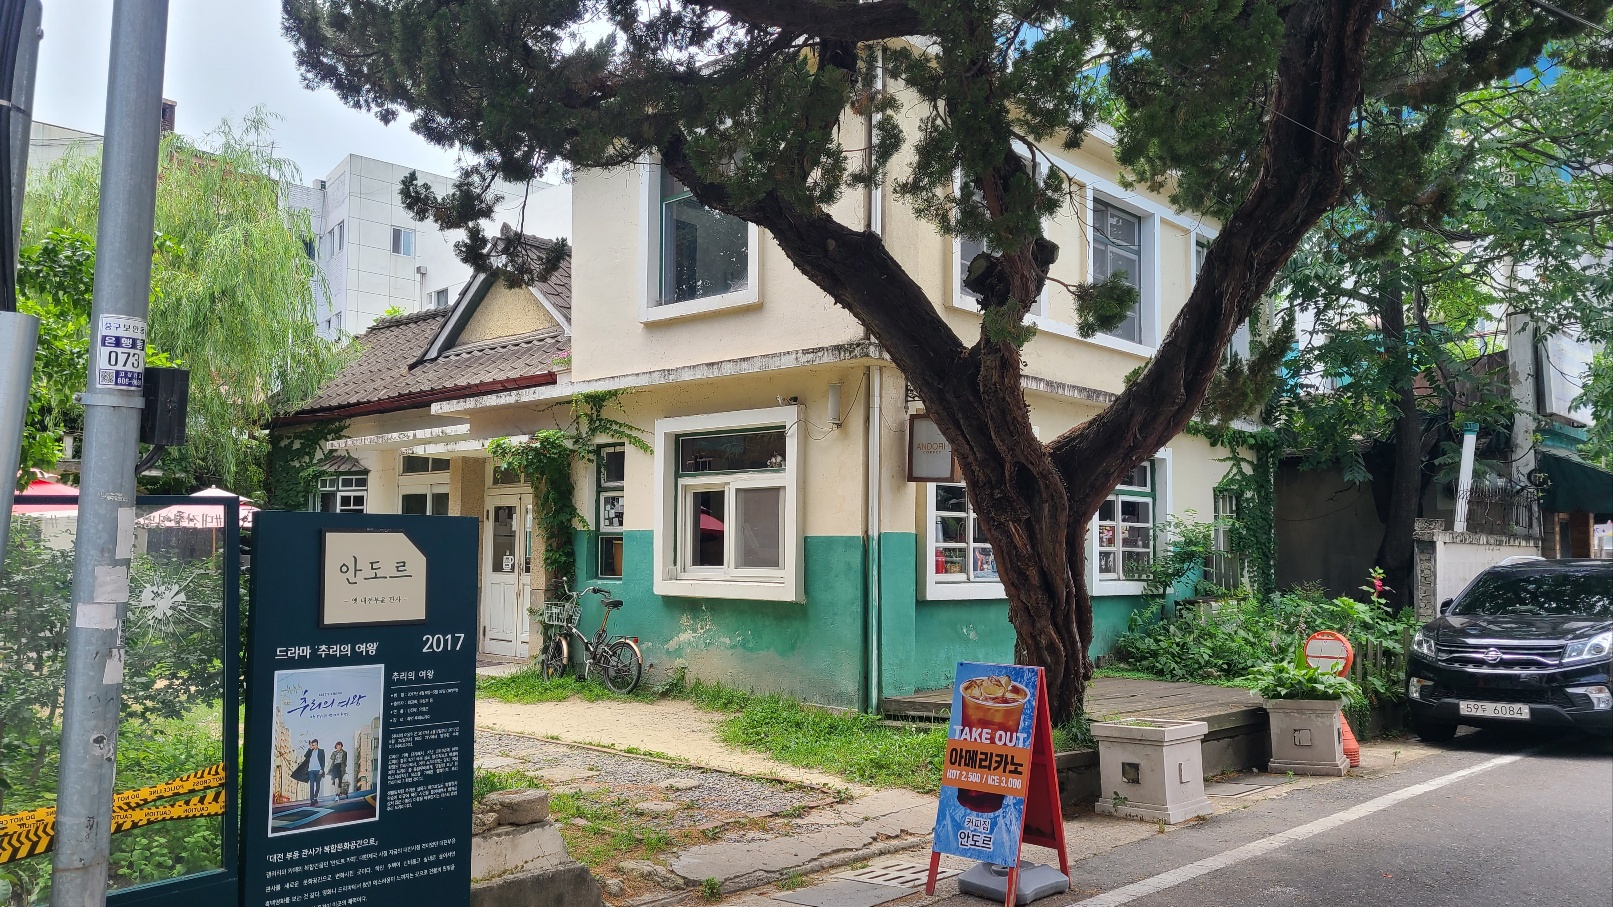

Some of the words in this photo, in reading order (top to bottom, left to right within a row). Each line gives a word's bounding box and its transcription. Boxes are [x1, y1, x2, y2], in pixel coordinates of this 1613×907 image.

[105, 336, 144, 350] 은행동
[108, 350, 140, 368] 073
[339, 555, 413, 585] 안도르
[422, 633, 465, 653] 2017
[274, 646, 311, 660] 드라마
[392, 670, 416, 682] 추리의
[418, 670, 434, 680] 여왕
[1493, 704, 1524, 716] 6084
[952, 725, 991, 744] TAKE
[994, 730, 1028, 748] OUT
[949, 748, 1024, 776] 아메리카노
[946, 768, 960, 780] HOT
[961, 770, 981, 784] 2,500
[988, 774, 1000, 786] ICE
[1000, 777, 1022, 789] 3,000
[965, 816, 991, 832] 커피집
[958, 830, 993, 850] 안도르
[286, 850, 300, 860] 부윤
[302, 846, 322, 858] 관사가
